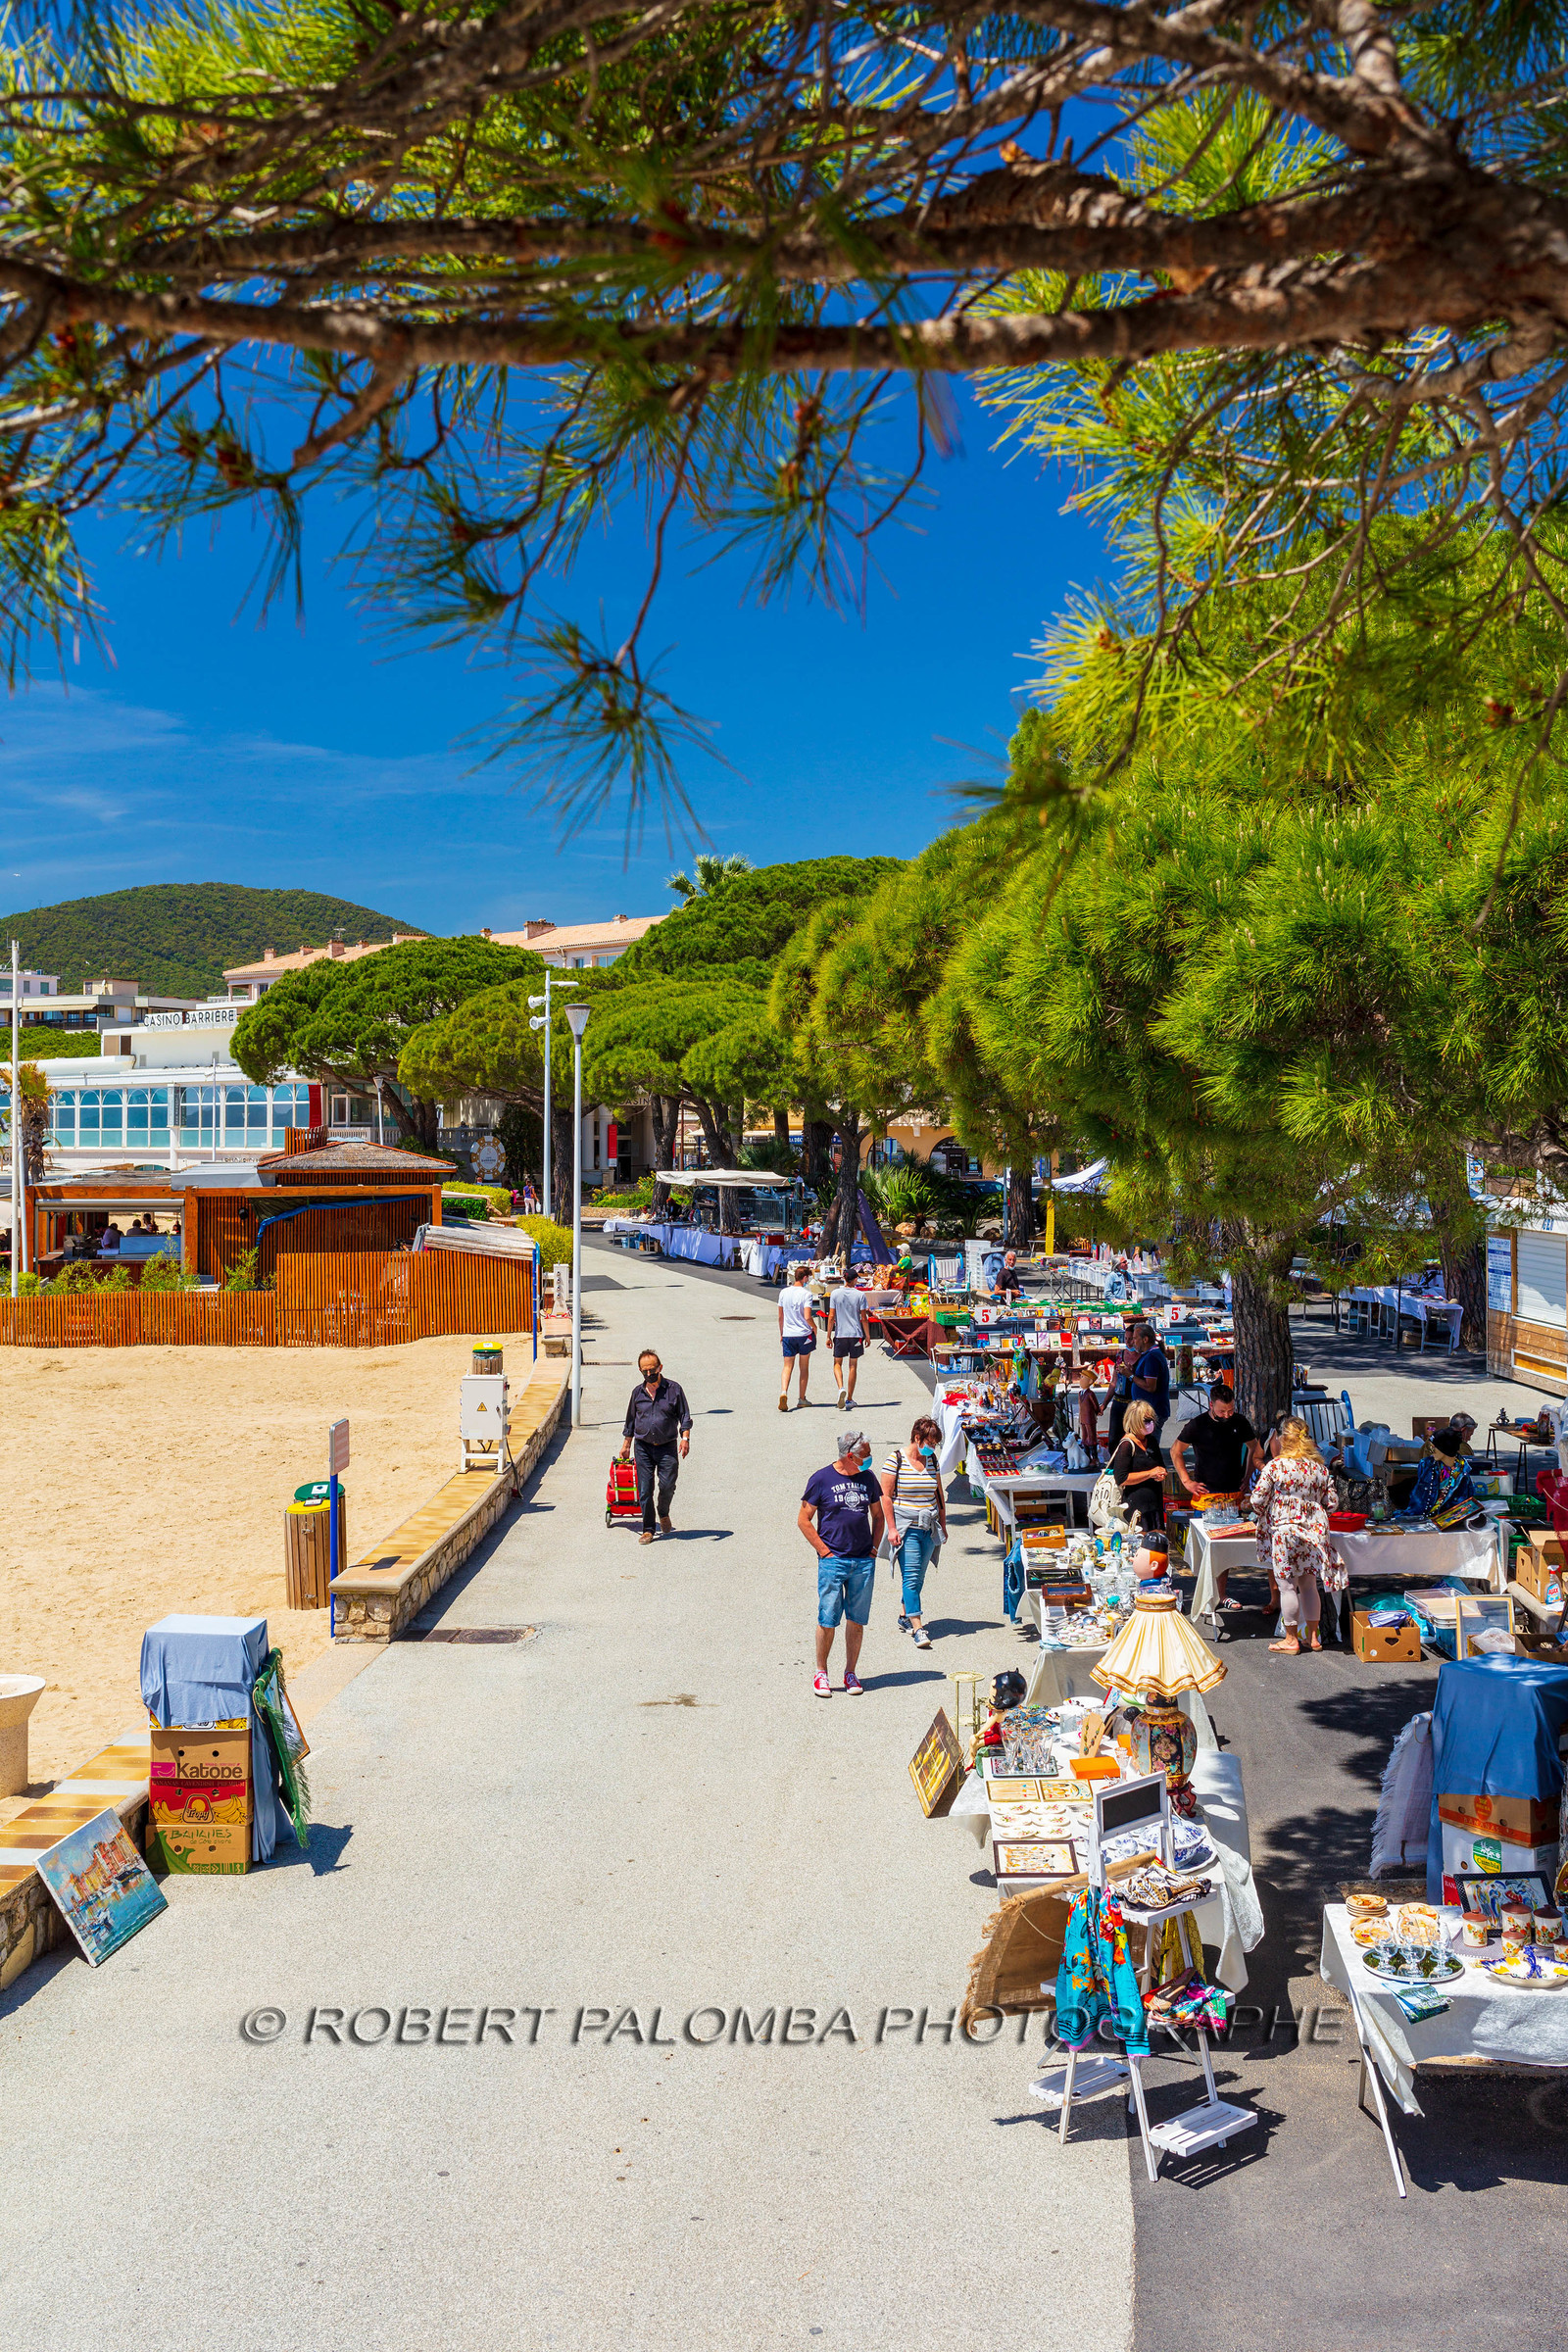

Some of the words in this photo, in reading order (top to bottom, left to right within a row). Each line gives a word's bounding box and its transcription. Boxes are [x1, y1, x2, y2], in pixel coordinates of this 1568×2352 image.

[143, 1013, 180, 1027] CASINO
[831, 1482, 846, 1493] TOM
[833, 1494, 844, 1502] 19
[186, 1808, 210, 1821] Tropy
[170, 1828, 232, 1839] BANANES
